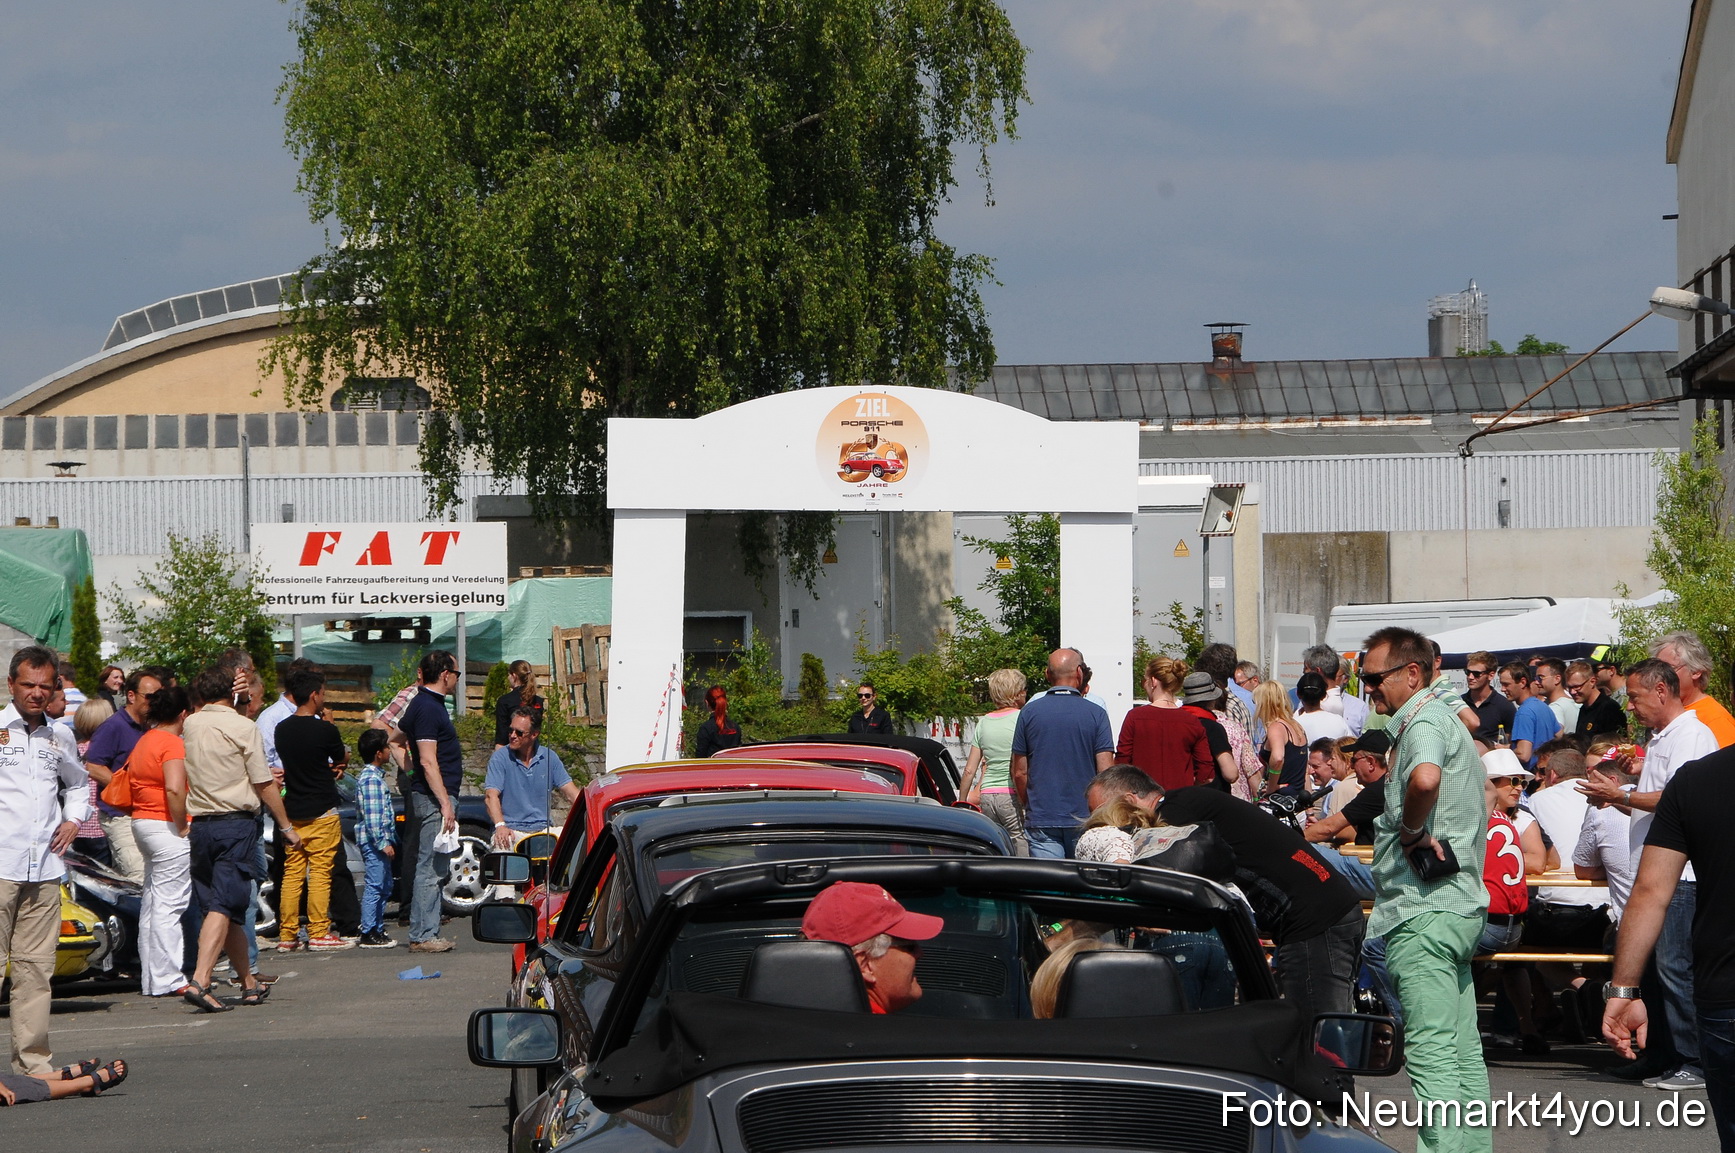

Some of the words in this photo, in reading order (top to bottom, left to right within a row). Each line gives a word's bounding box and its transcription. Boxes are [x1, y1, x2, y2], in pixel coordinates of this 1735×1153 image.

[855, 398, 890, 417] ZIEL
[325, 575, 429, 585] Fahrzeugaufbereitung
[431, 575, 449, 584] und
[452, 575, 505, 585] Veredelung
[331, 591, 355, 605] für
[360, 591, 506, 607] Lackversiegelung
[1486, 824, 1525, 886] 3
